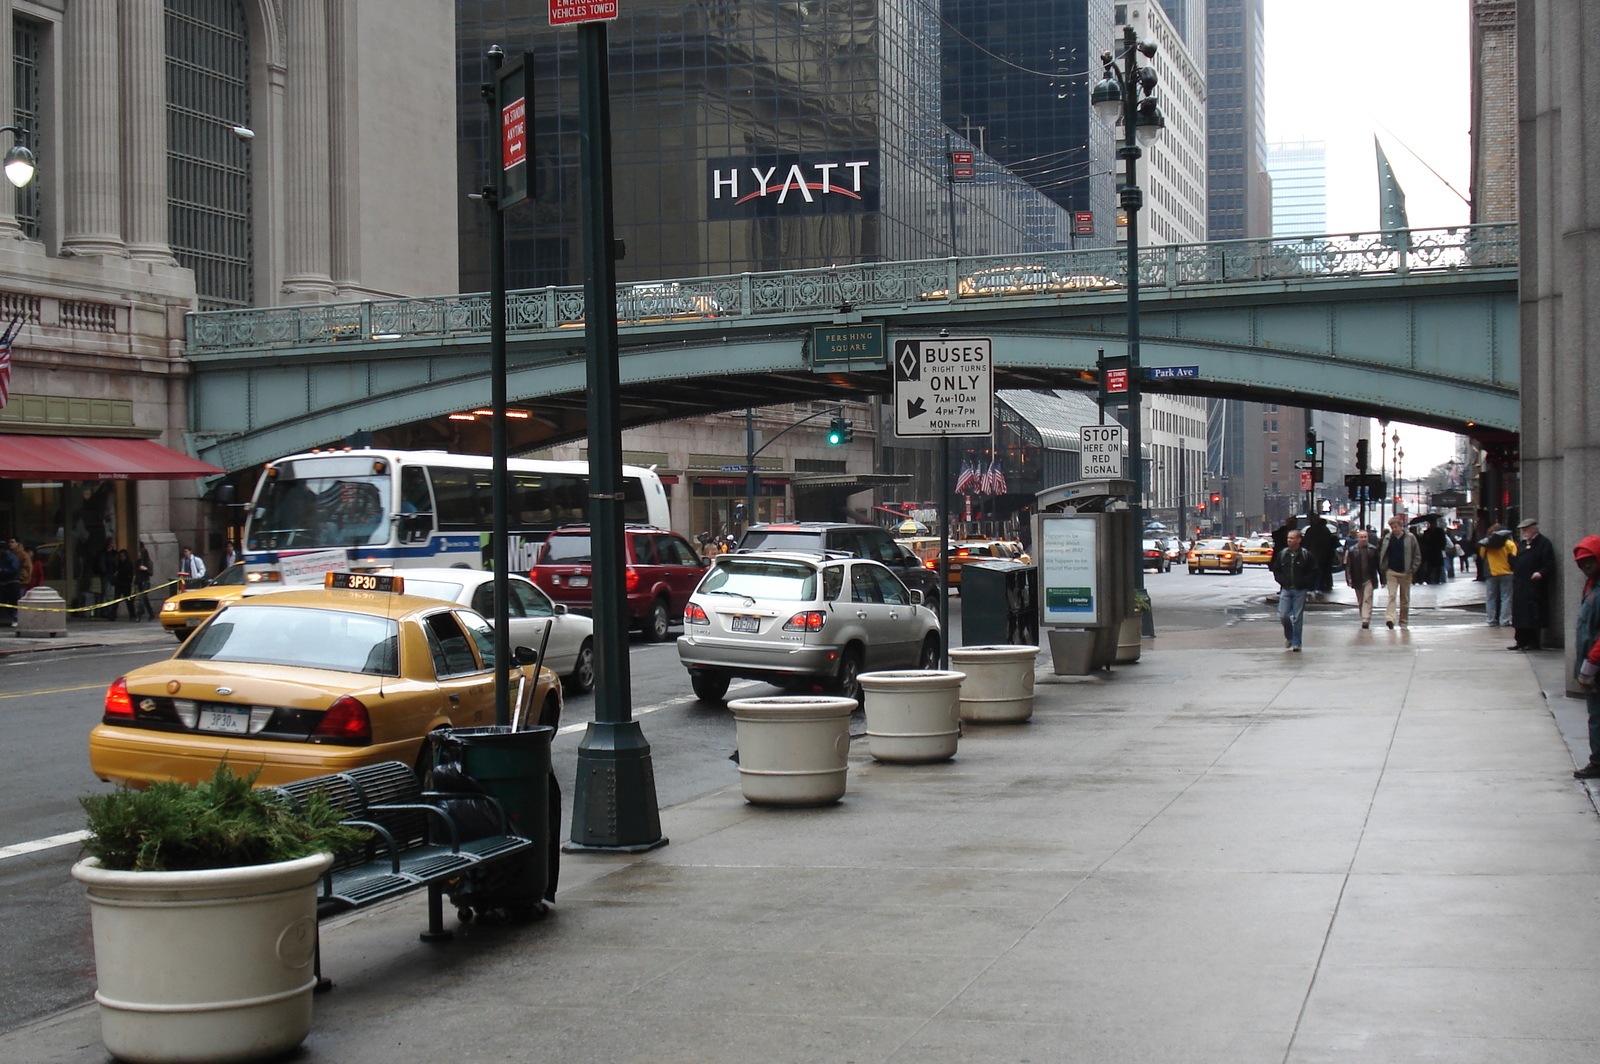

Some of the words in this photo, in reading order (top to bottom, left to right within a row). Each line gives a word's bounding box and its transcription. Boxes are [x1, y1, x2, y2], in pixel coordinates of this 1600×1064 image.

[552, 6, 586, 18] VEHICLES
[590, 3, 614, 14] TOWED
[504, 113, 510, 126] NO
[510, 104, 525, 122] STANDIN
[507, 122, 524, 141] ANYTIME
[714, 161, 869, 204] HYATT
[826, 333, 872, 342] PERSHING
[832, 344, 866, 352] SQUARE
[926, 347, 983, 363] BUSES
[1155, 368, 1174, 377] Park
[930, 375, 979, 390] ONLY
[934, 394, 976, 403] 7AM-10AM
[935, 406, 975, 415] 4PM-7PM
[1084, 430, 1118, 441] STOP
[1084, 444, 1103, 452] HERE
[348, 575, 376, 589] 3P30
